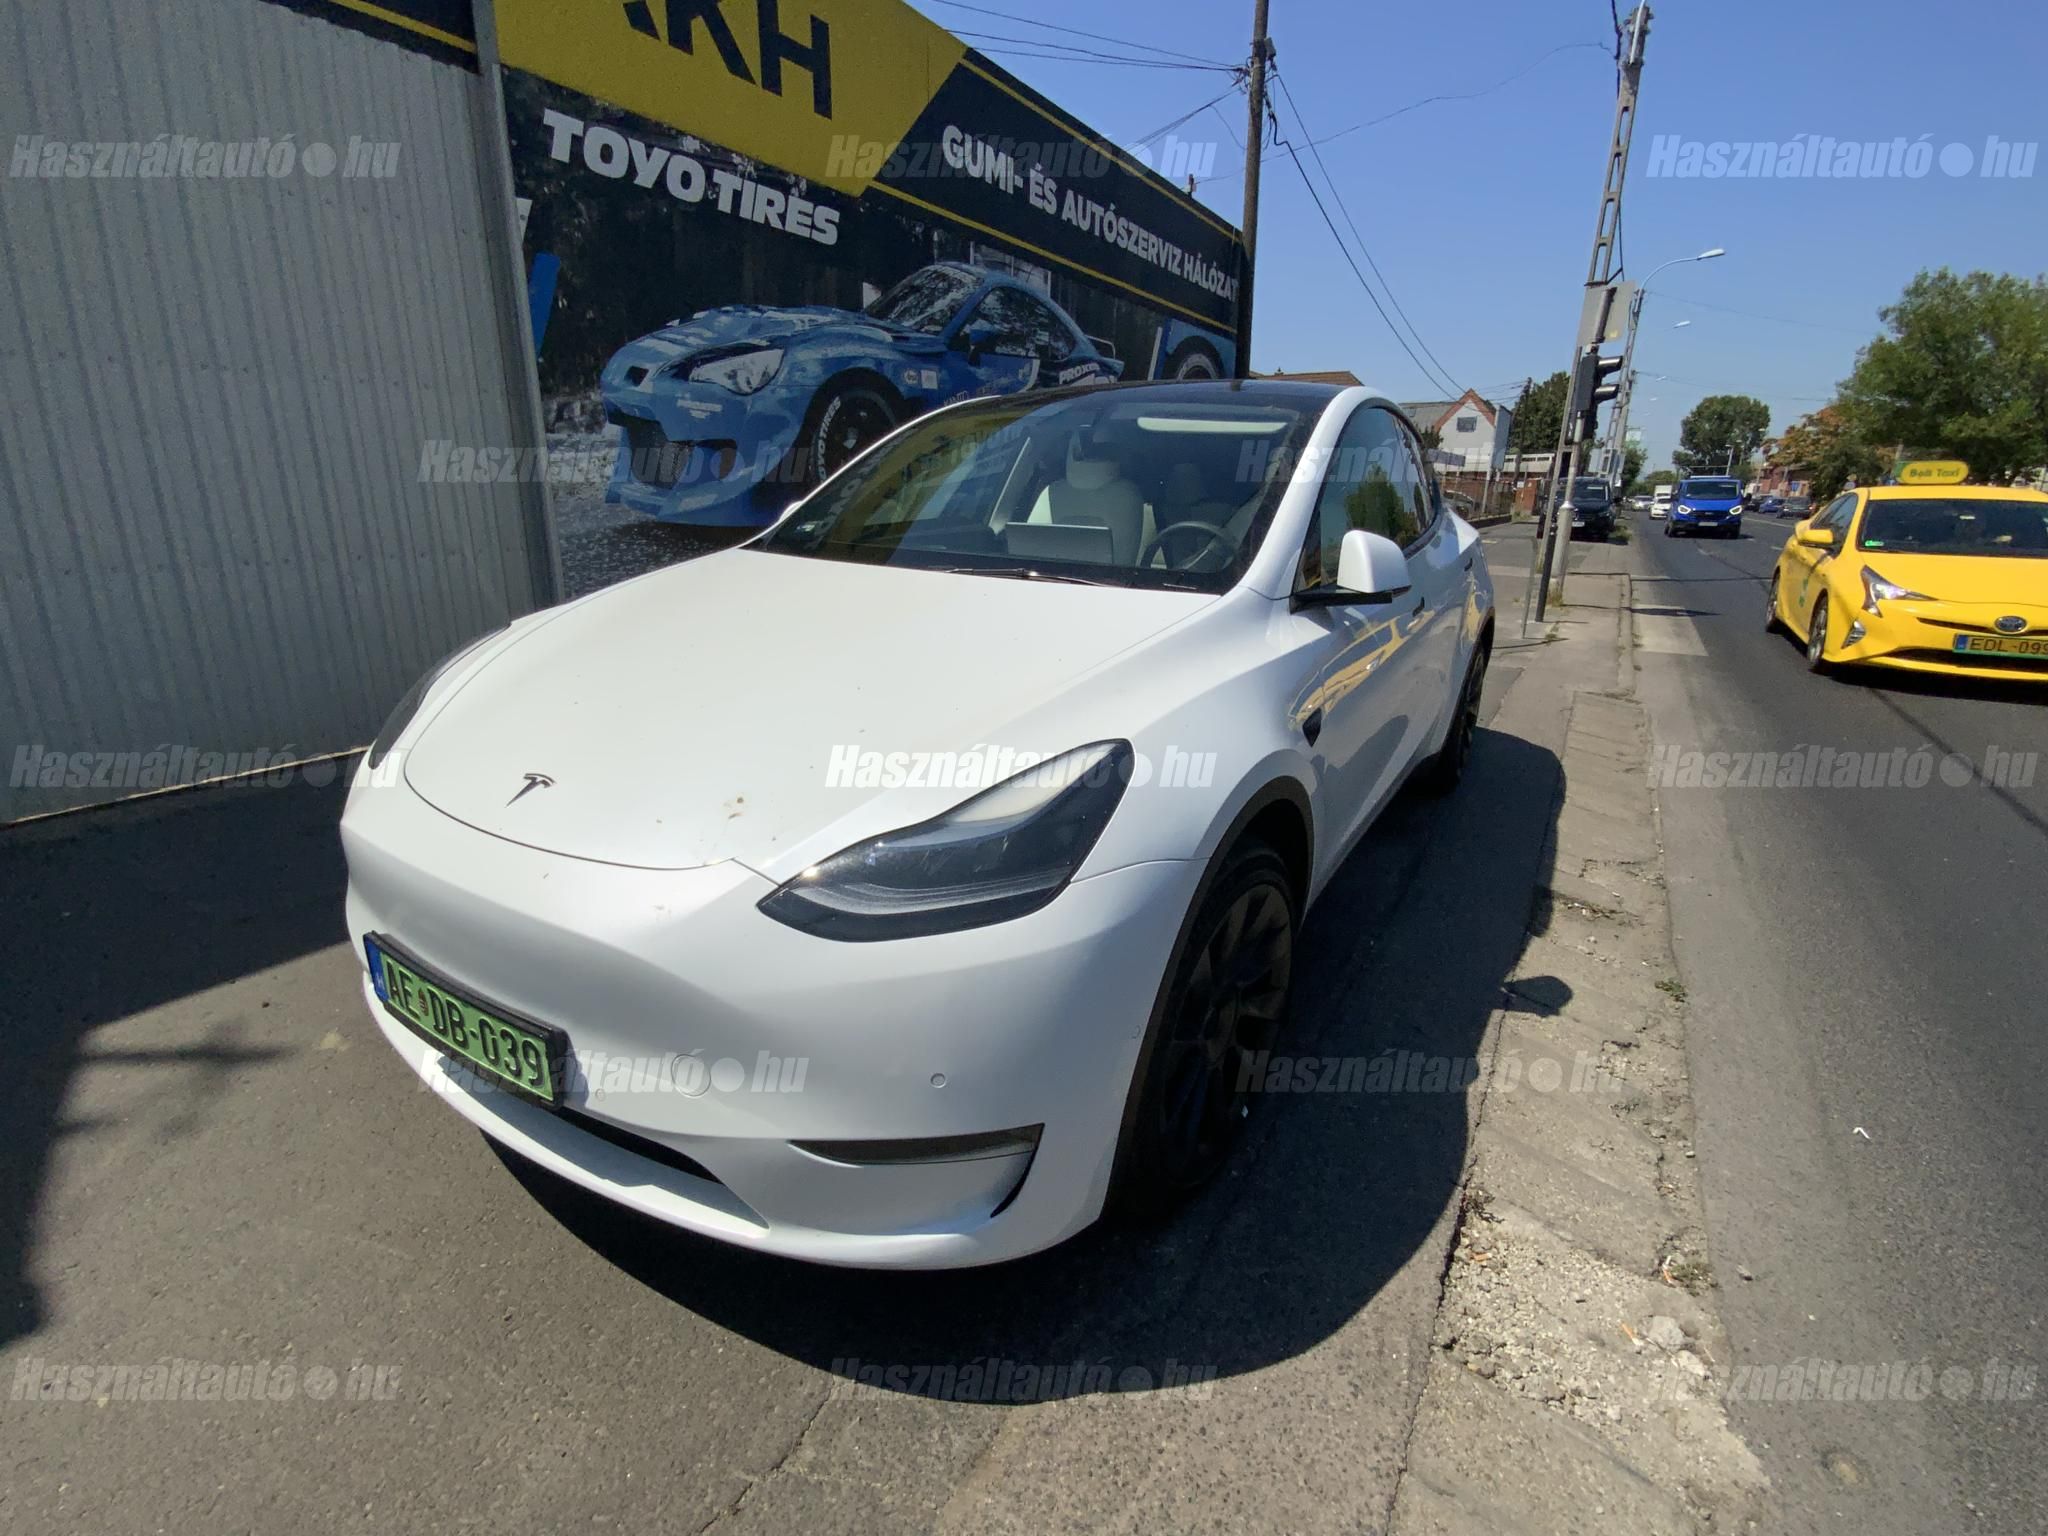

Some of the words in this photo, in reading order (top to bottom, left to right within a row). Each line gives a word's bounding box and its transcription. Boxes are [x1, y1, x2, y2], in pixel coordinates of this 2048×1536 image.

[543, 108, 707, 203] TOYO
[712, 169, 841, 246] TIRES
[942, 124, 1024, 195] GUMI-
[1029, 163, 1058, 216] ÉS
[1061, 188, 1183, 276] AUTÓSZERVIZ
[1183, 252, 1240, 303] HÁLÓZAT
[386, 958, 421, 1020] AE
[426, 985, 546, 1087] DB-039
